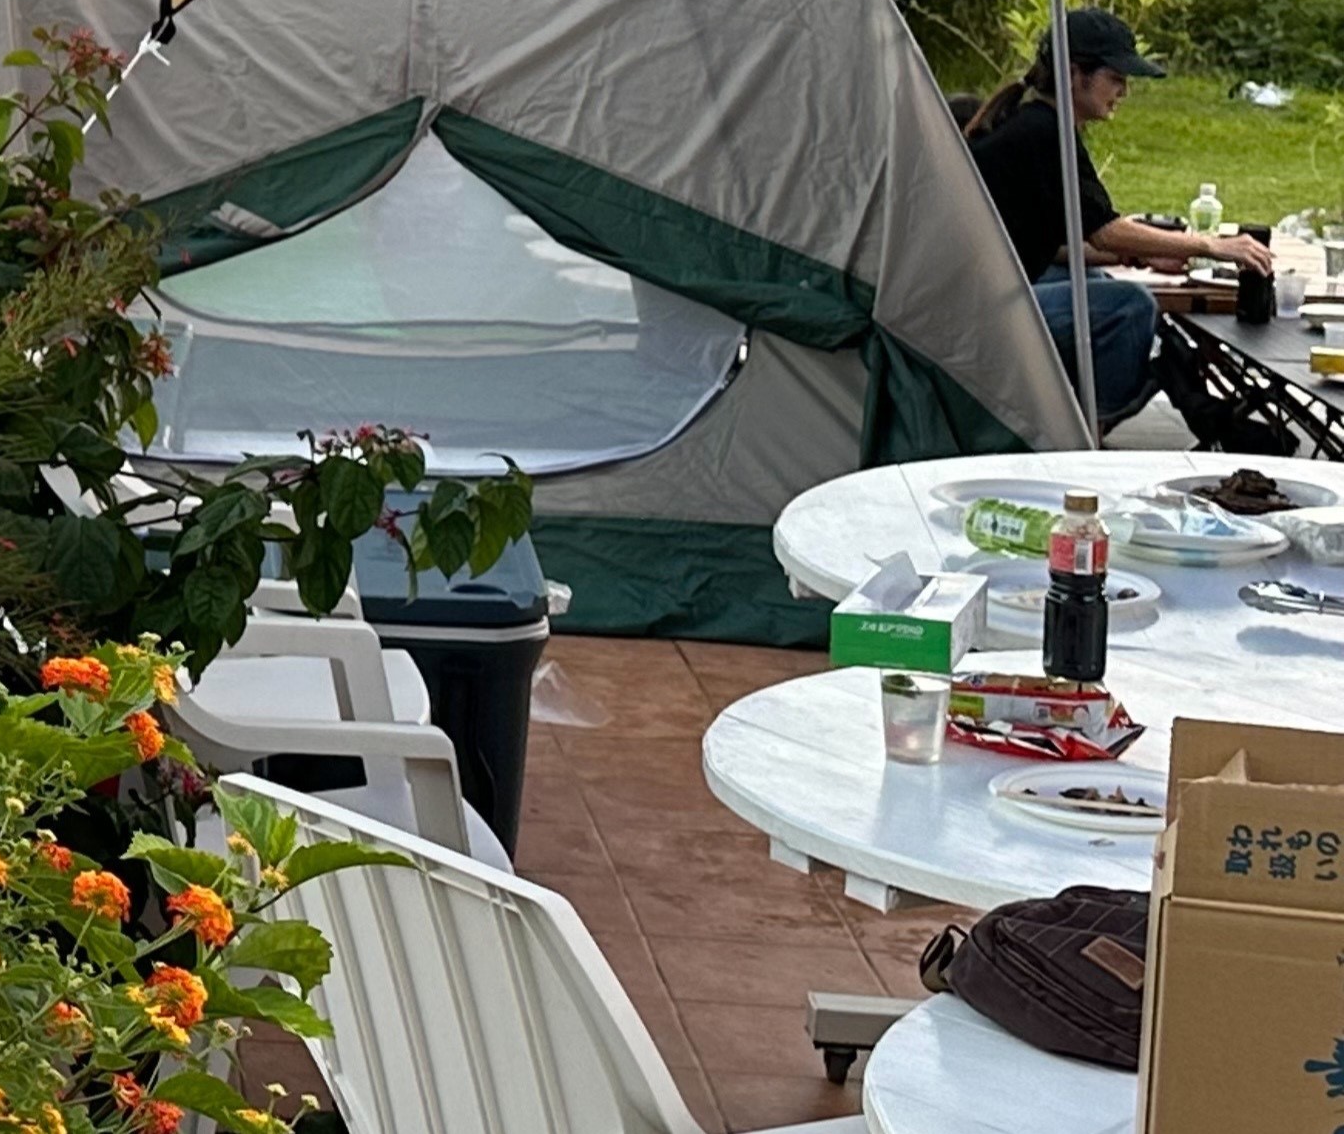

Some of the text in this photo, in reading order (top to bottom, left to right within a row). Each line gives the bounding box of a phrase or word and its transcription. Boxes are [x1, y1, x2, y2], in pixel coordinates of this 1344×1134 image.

[1226, 824, 1342, 856] われもの
[1224, 850, 1339, 881] 取扱い
